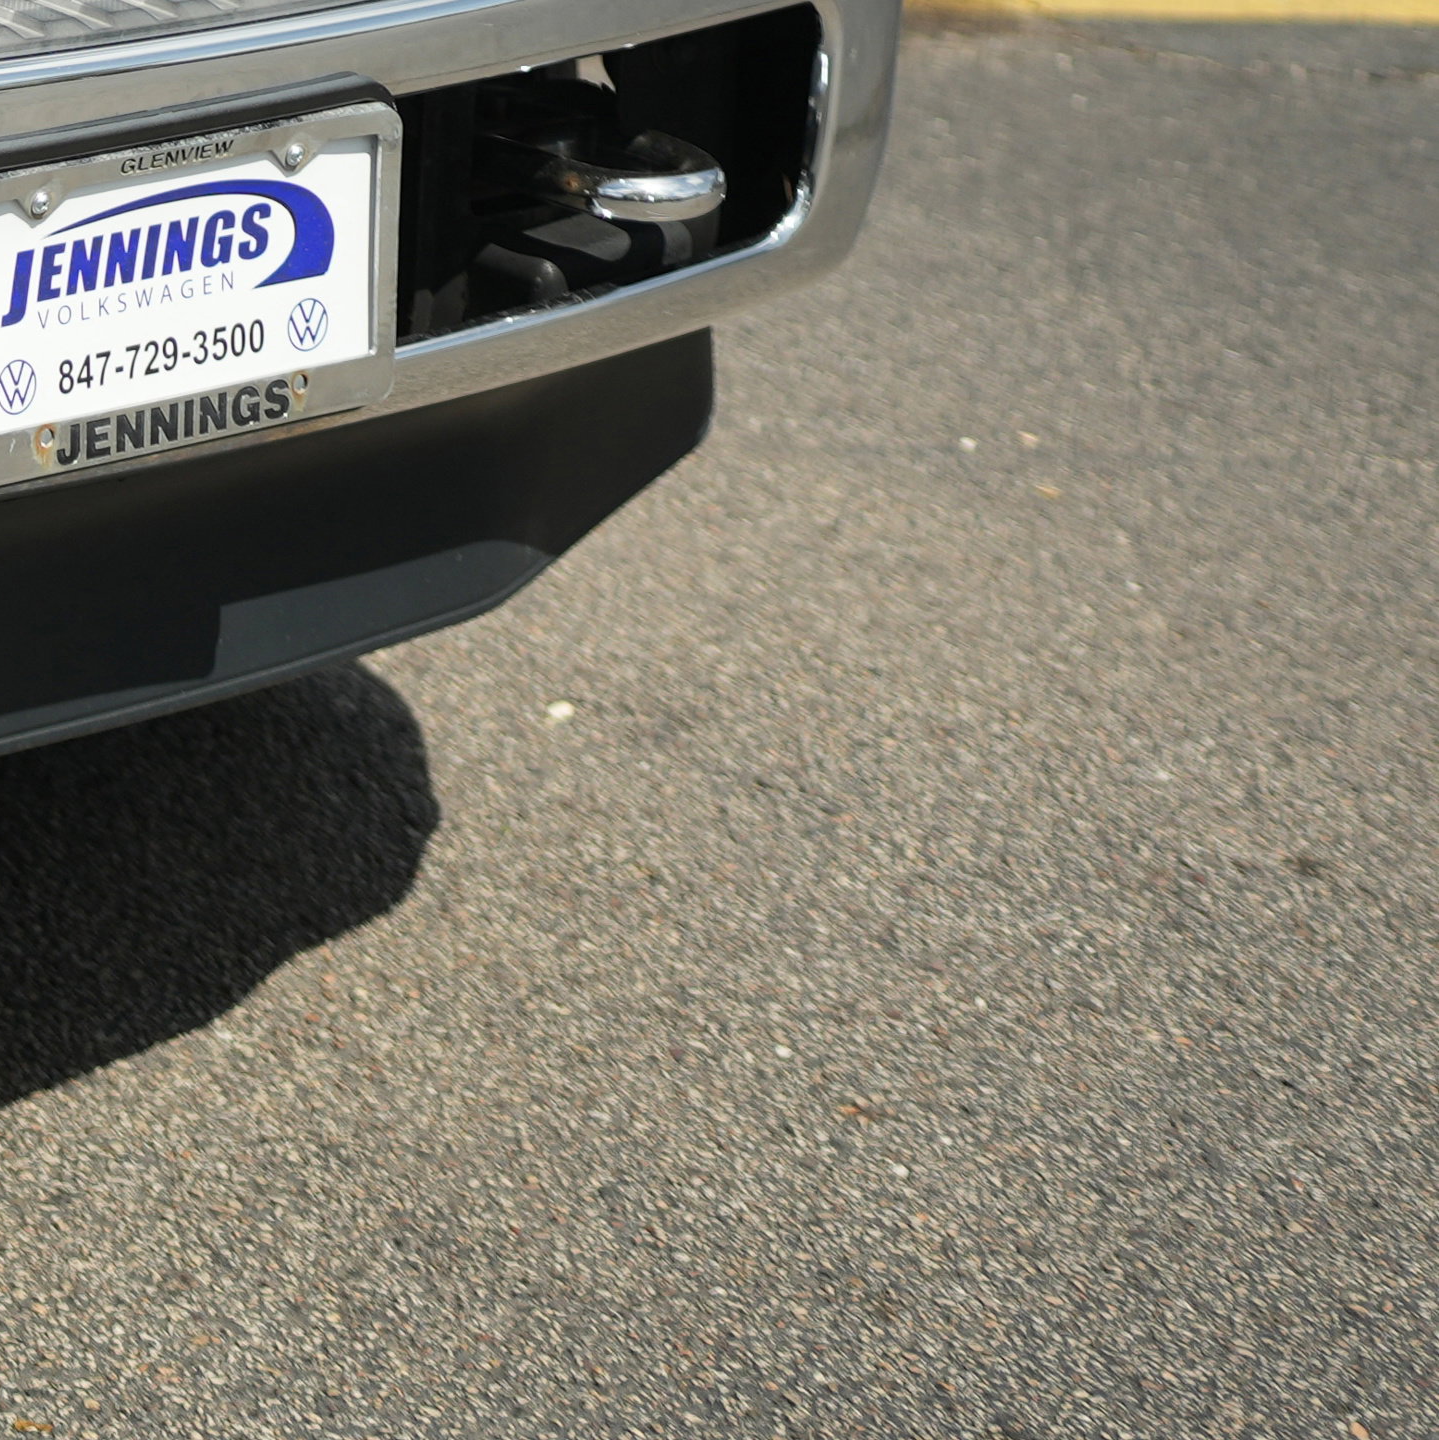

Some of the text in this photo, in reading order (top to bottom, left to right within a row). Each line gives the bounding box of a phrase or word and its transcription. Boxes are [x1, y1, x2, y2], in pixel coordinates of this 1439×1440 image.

[120, 139, 235, 175] GLENVIEW
[1, 202, 272, 328] JENNINGS
[37, 271, 235, 329] VOLKSWAGEN
[58, 319, 266, 395] 847-729-3500
[56, 378, 292, 466] JENNINGS
